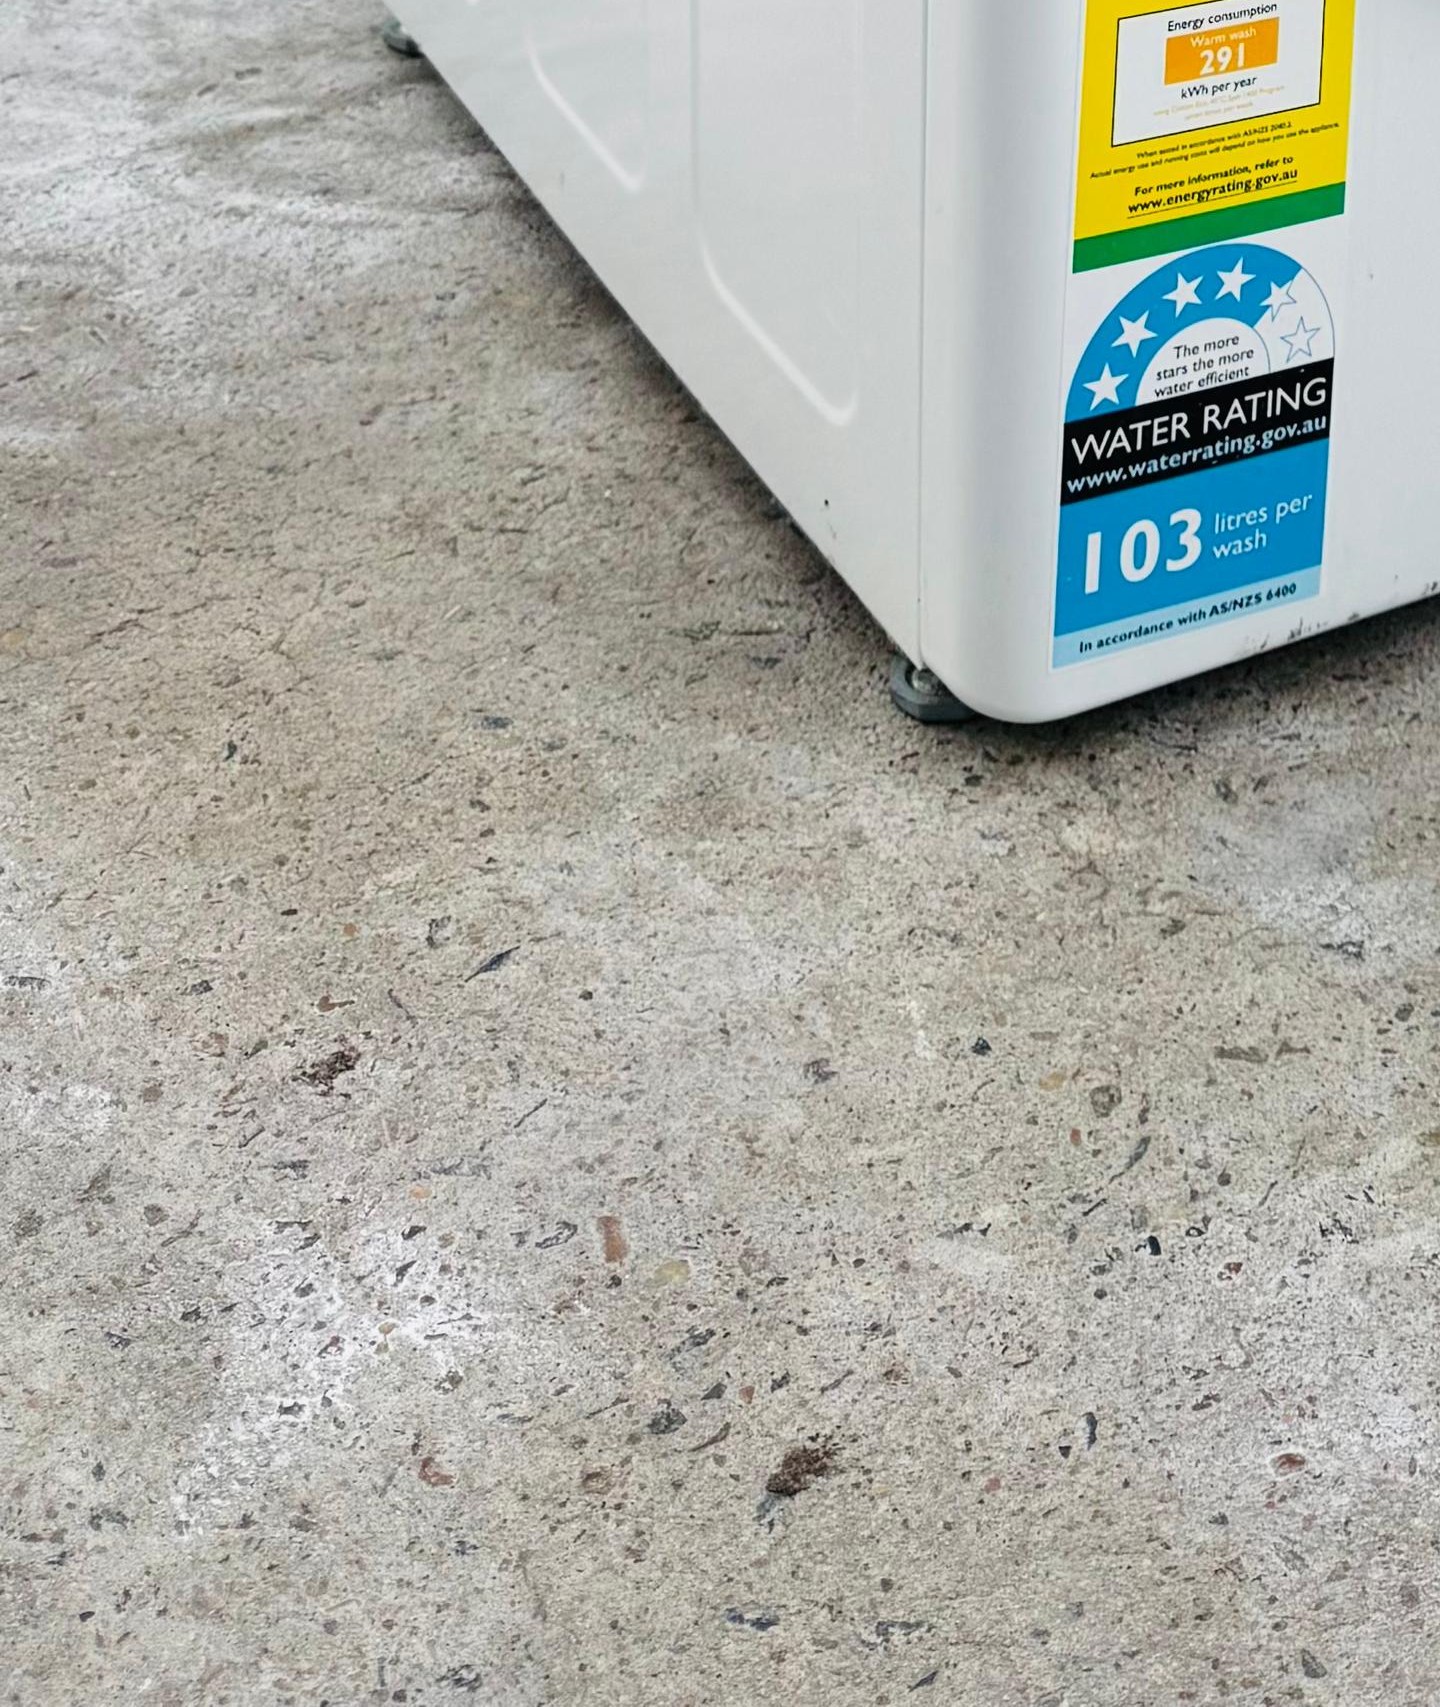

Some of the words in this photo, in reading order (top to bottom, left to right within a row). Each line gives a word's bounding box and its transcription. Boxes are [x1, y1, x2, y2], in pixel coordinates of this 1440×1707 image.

[1167, 17, 1205, 32] Energy
[1208, 3, 1278, 24] consumption
[1190, 34, 1226, 48] Warm
[1229, 27, 1257, 41] wash
[1200, 42, 1245, 75] 291
[1181, 84, 1208, 99] kWh
[1212, 82, 1230, 96] per
[1233, 76, 1258, 91] year
[1127, 169, 1298, 214] www.energyrating.gov.au
[1134, 185, 1154, 196] For
[1155, 179, 1186, 193] more
[1187, 165, 1252, 185] information,
[1254, 157, 1280, 171] refer
[1282, 156, 1294, 165] to
[1173, 344, 1200, 359] The
[1203, 335, 1239, 352] more
[1156, 364, 1188, 381] stars
[1192, 357, 1214, 372] the
[1218, 349, 1254, 366] more
[1154, 381, 1194, 398] water
[1197, 366, 1249, 388] efficient
[1070, 411, 1191, 465] WATER
[1202, 376, 1327, 435] RATING
[1066, 415, 1328, 494] www.waterrating.gov.au
[1084, 508, 1202, 595] 103
[1214, 506, 1268, 534] litres
[1275, 494, 1313, 524] per
[1212, 529, 1268, 559] wash
[1079, 640, 1093, 654] In
[1096, 620, 1174, 649] accordance
[1177, 608, 1207, 626] with
[1208, 592, 1263, 618] AS/NZS
[1265, 582, 1297, 602] 6400
